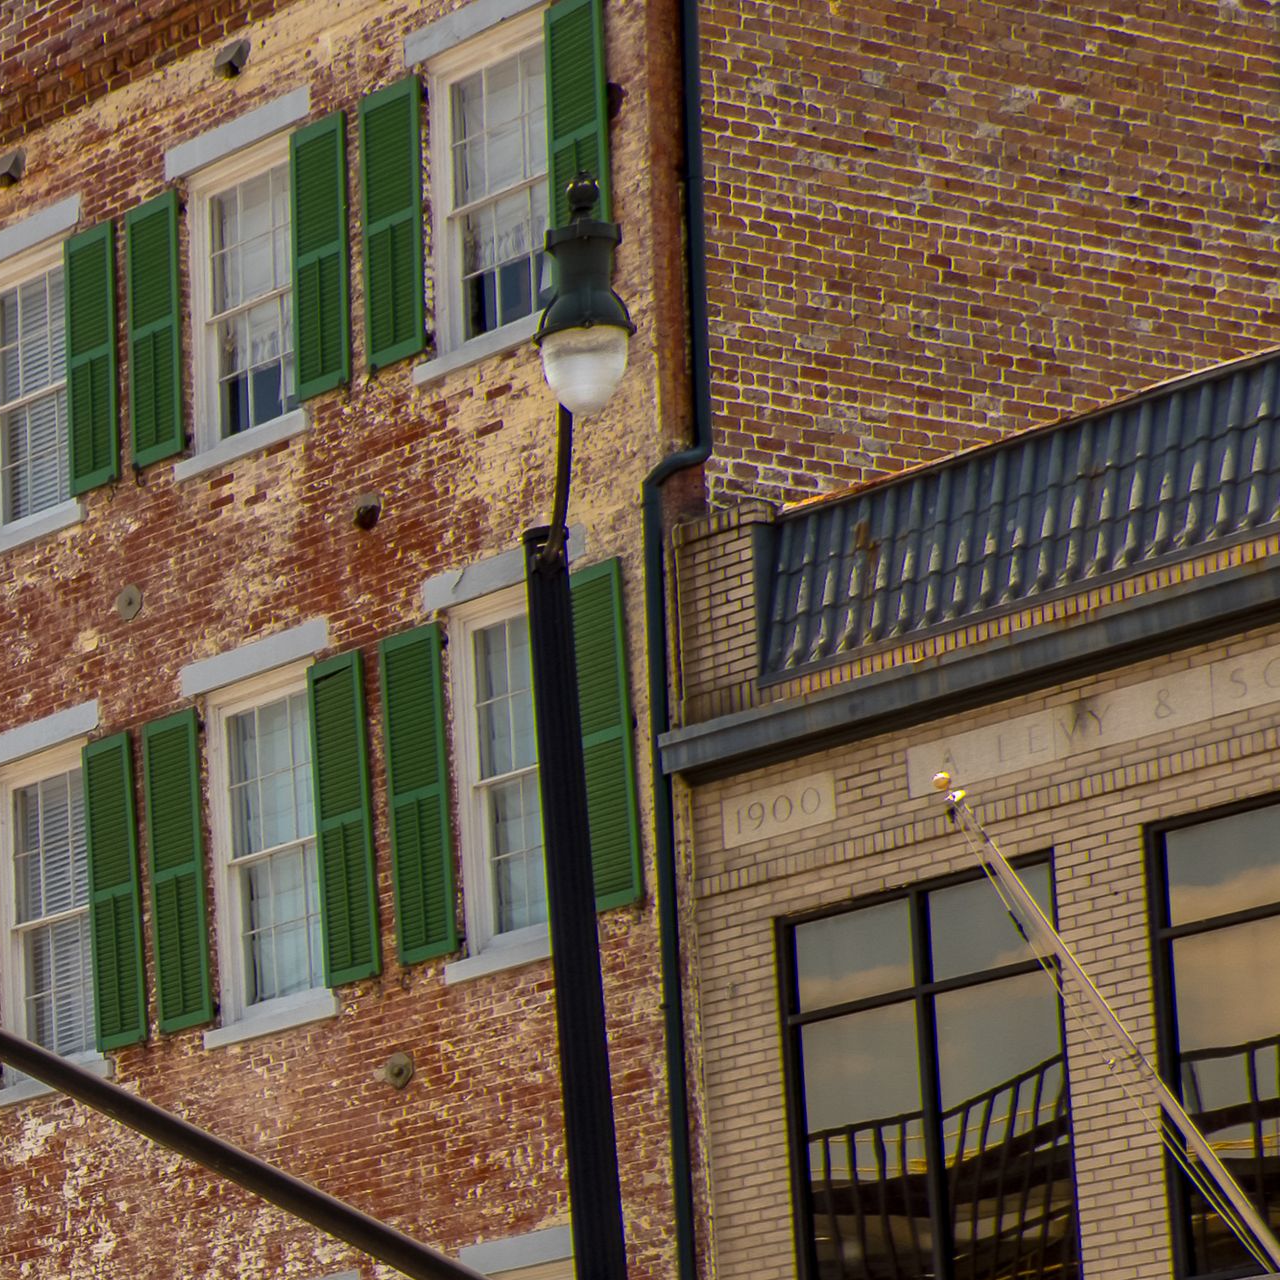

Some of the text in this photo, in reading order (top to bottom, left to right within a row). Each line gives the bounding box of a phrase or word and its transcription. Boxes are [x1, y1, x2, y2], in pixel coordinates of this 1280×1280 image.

[997, 703, 1112, 763] LEVY
[1153, 688, 1176, 720] &
[737, 787, 821, 834] 1900
